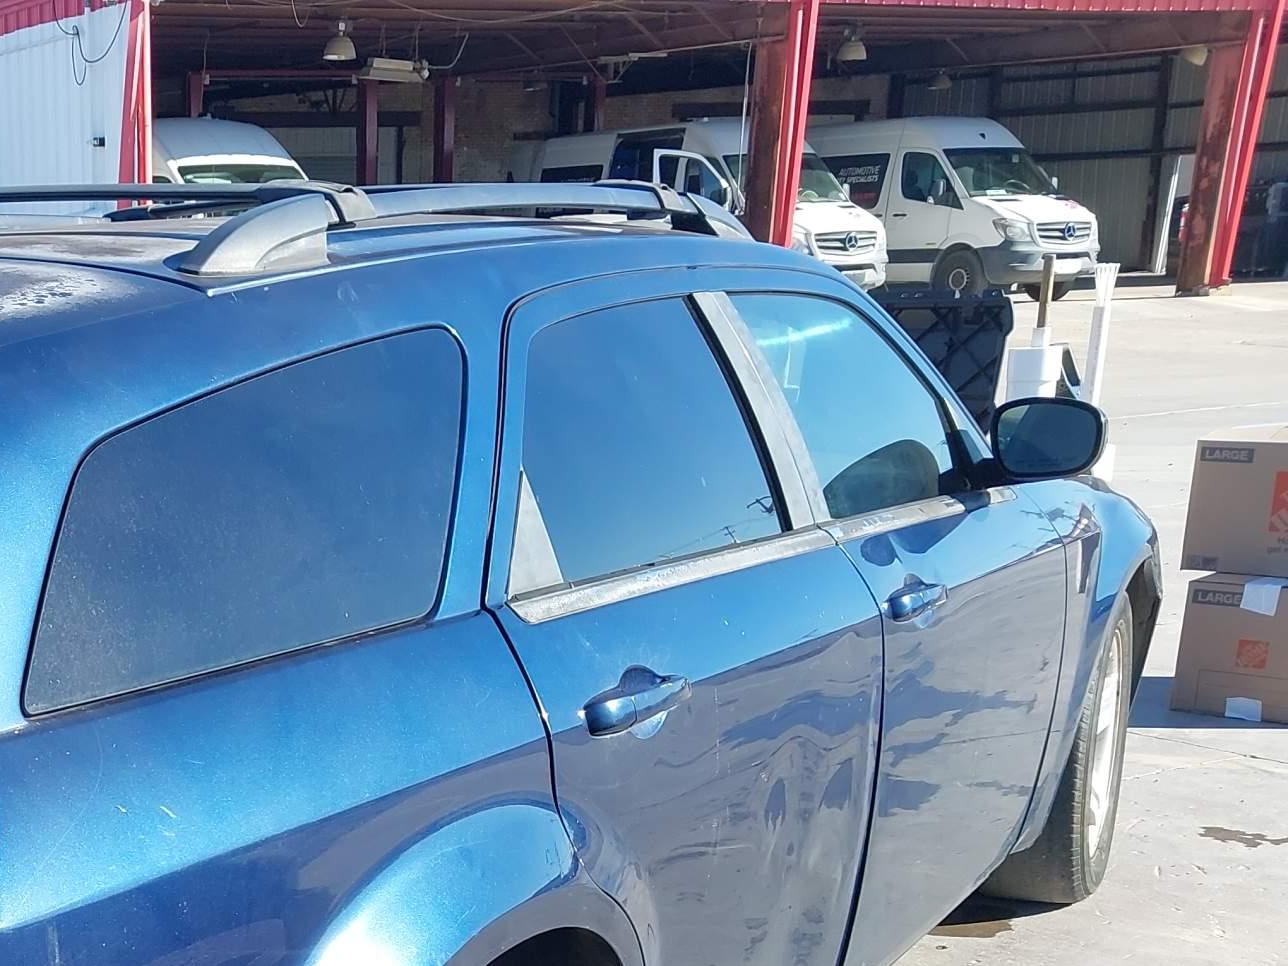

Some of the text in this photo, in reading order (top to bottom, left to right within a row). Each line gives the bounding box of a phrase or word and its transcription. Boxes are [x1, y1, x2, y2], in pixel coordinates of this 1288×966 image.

[839, 165, 880, 176] AUTOMOTIVE
[846, 175, 879, 184] SPECIALISTS
[1206, 448, 1249, 460] LARGE
[1198, 591, 1242, 605] LARGE
